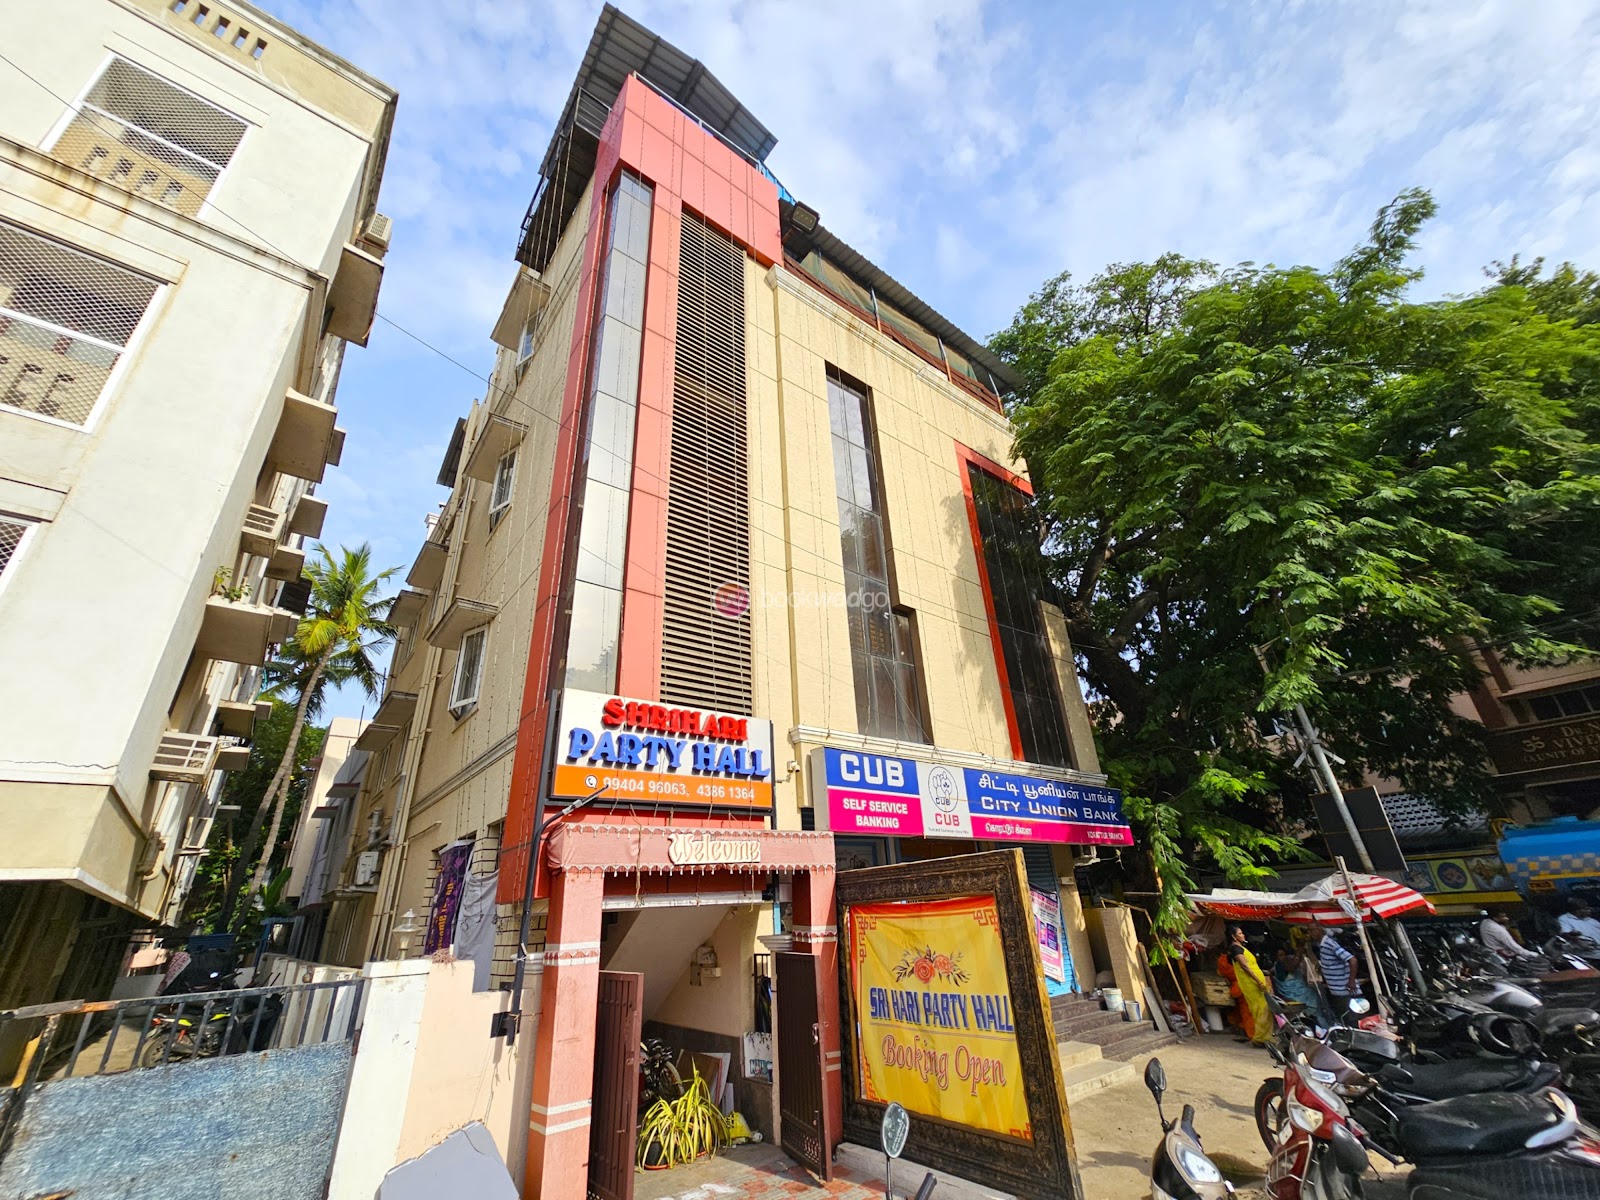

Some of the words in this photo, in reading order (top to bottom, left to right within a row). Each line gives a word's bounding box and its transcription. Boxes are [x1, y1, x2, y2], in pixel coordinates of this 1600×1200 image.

[602, 698, 748, 741] SHRIHARI
[568, 727, 688, 768] PARTY
[692, 743, 770, 777] HALL
[840, 753, 904, 787] CUB
[603, 777, 645, 791] 99404
[648, 781, 690, 796] 96063,
[697, 784, 725, 798] 4386
[729, 787, 754, 799] 1364
[978, 774, 1019, 796] சிட்டி
[1023, 783, 1079, 800] யூனியன்
[843, 798, 867, 811] SELF
[869, 800, 908, 814] SERVICE
[935, 797, 951, 806] CUB
[856, 815, 899, 828] BANKING
[935, 813, 960, 826] CUB
[668, 833, 761, 864] Welcome
[870, 987, 890, 1020] SRI
[891, 989, 921, 1025] HARI
[922, 992, 969, 1029] PARTY
[971, 995, 1015, 1032] HALL
[882, 1034, 948, 1090] Booking
[955, 1045, 1006, 1096] Open
